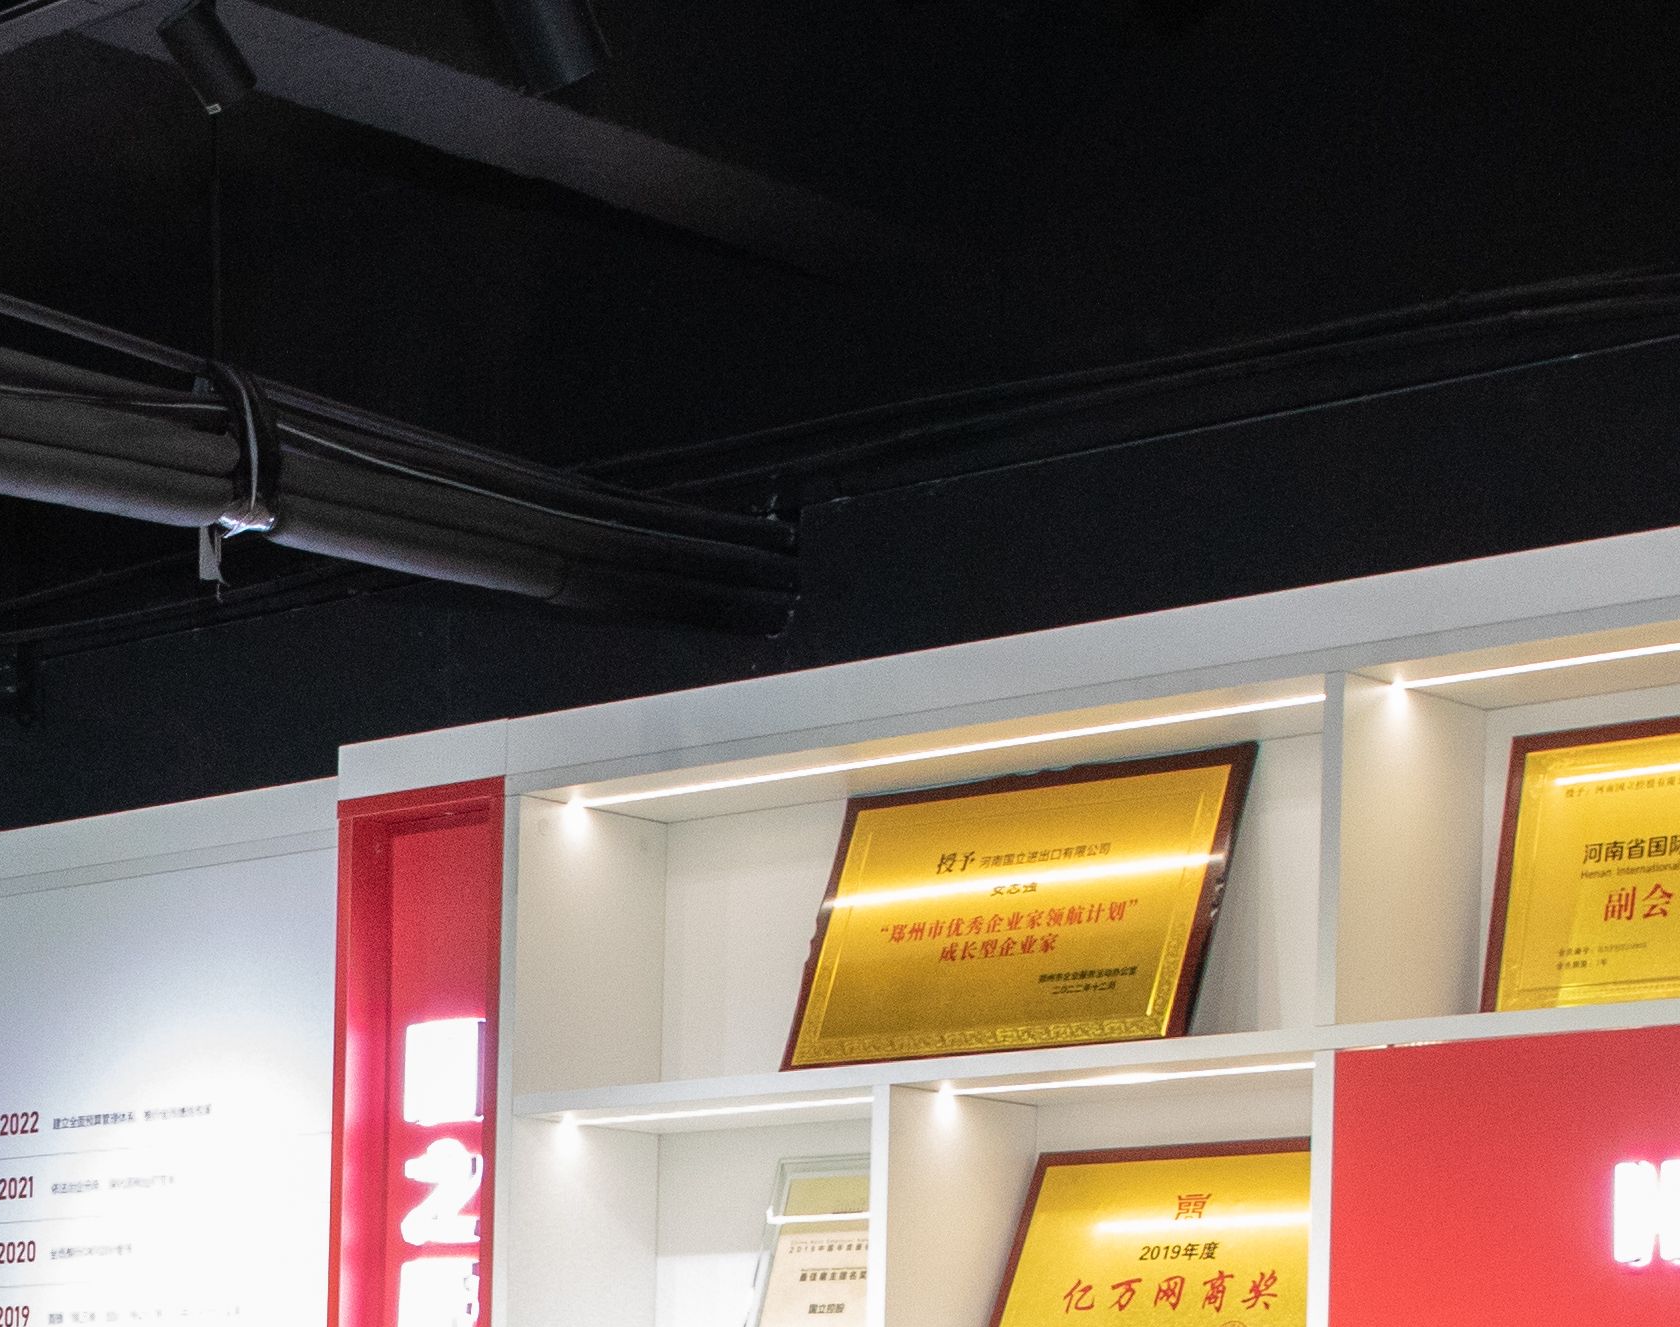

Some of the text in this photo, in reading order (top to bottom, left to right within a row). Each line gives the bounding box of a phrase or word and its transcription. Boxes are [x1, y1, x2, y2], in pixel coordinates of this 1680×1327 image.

[939, 934, 1057, 964] 成长型企业家
[0, 1111, 39, 1137] 2022
[1137, 1240, 1221, 1262] 2019年度
[1062, 1270, 1280, 1315] 亿万网商奖
